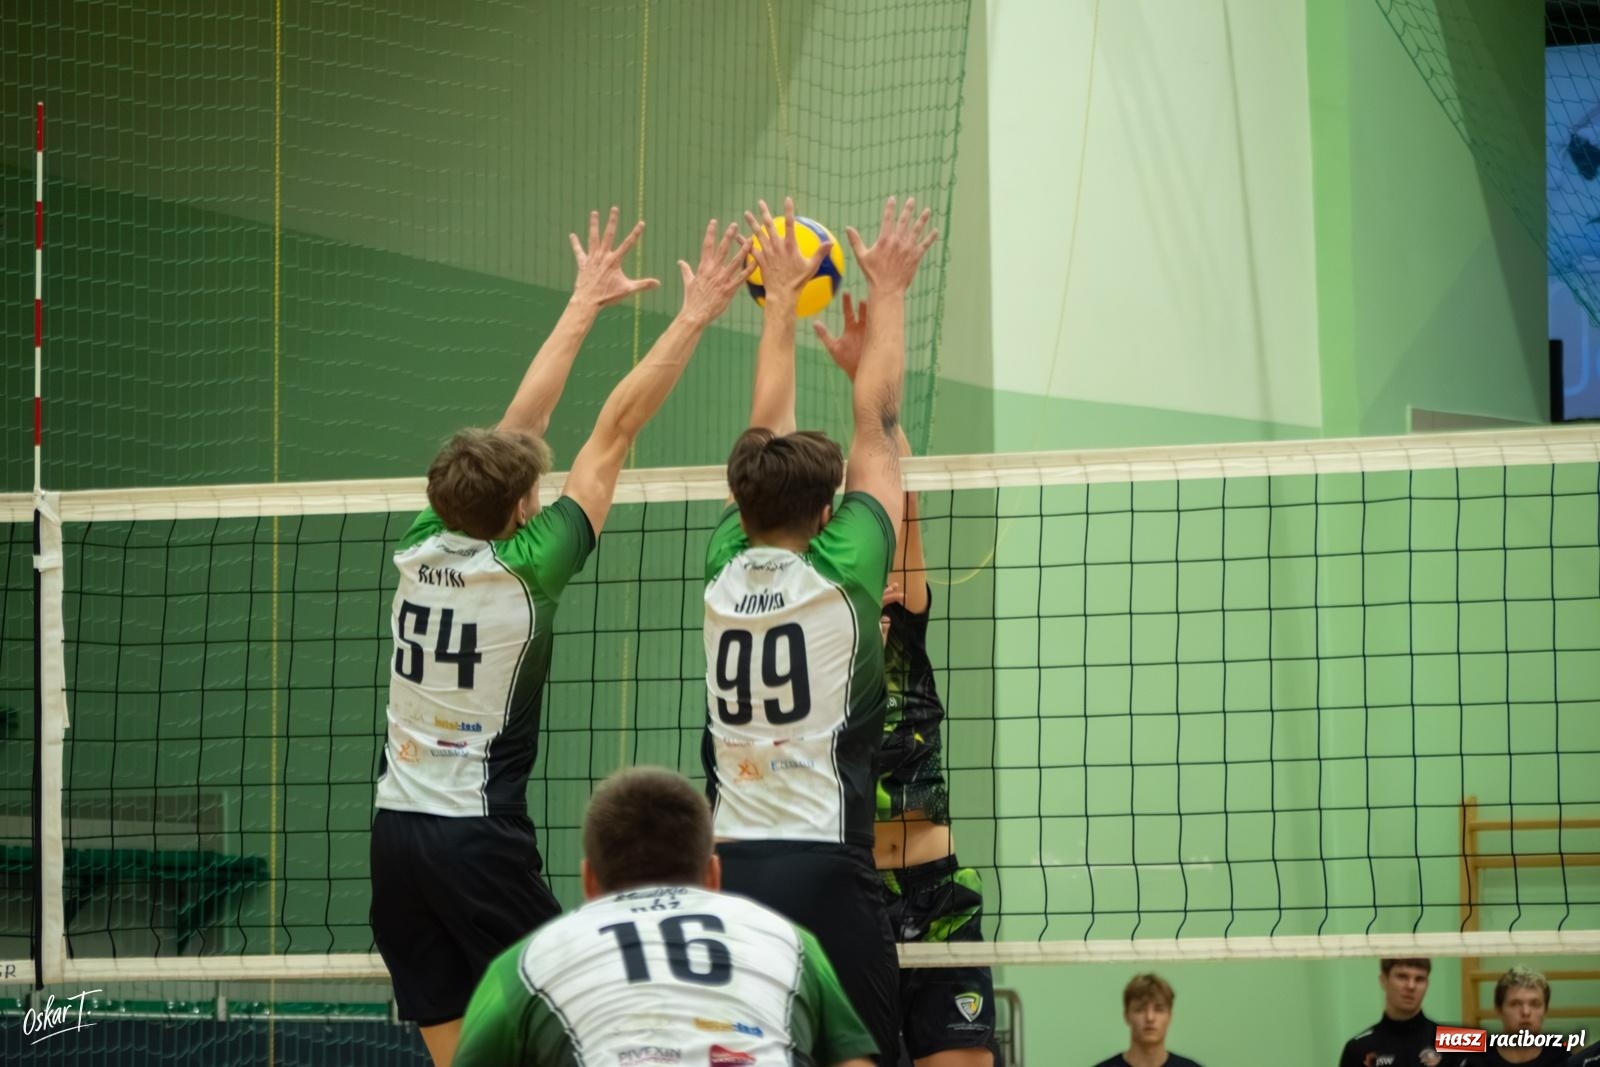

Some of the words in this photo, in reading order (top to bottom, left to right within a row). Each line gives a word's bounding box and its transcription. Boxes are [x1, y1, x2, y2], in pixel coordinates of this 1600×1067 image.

[395, 599, 482, 689] 54
[716, 622, 811, 726] 99
[598, 914, 733, 987] 16
